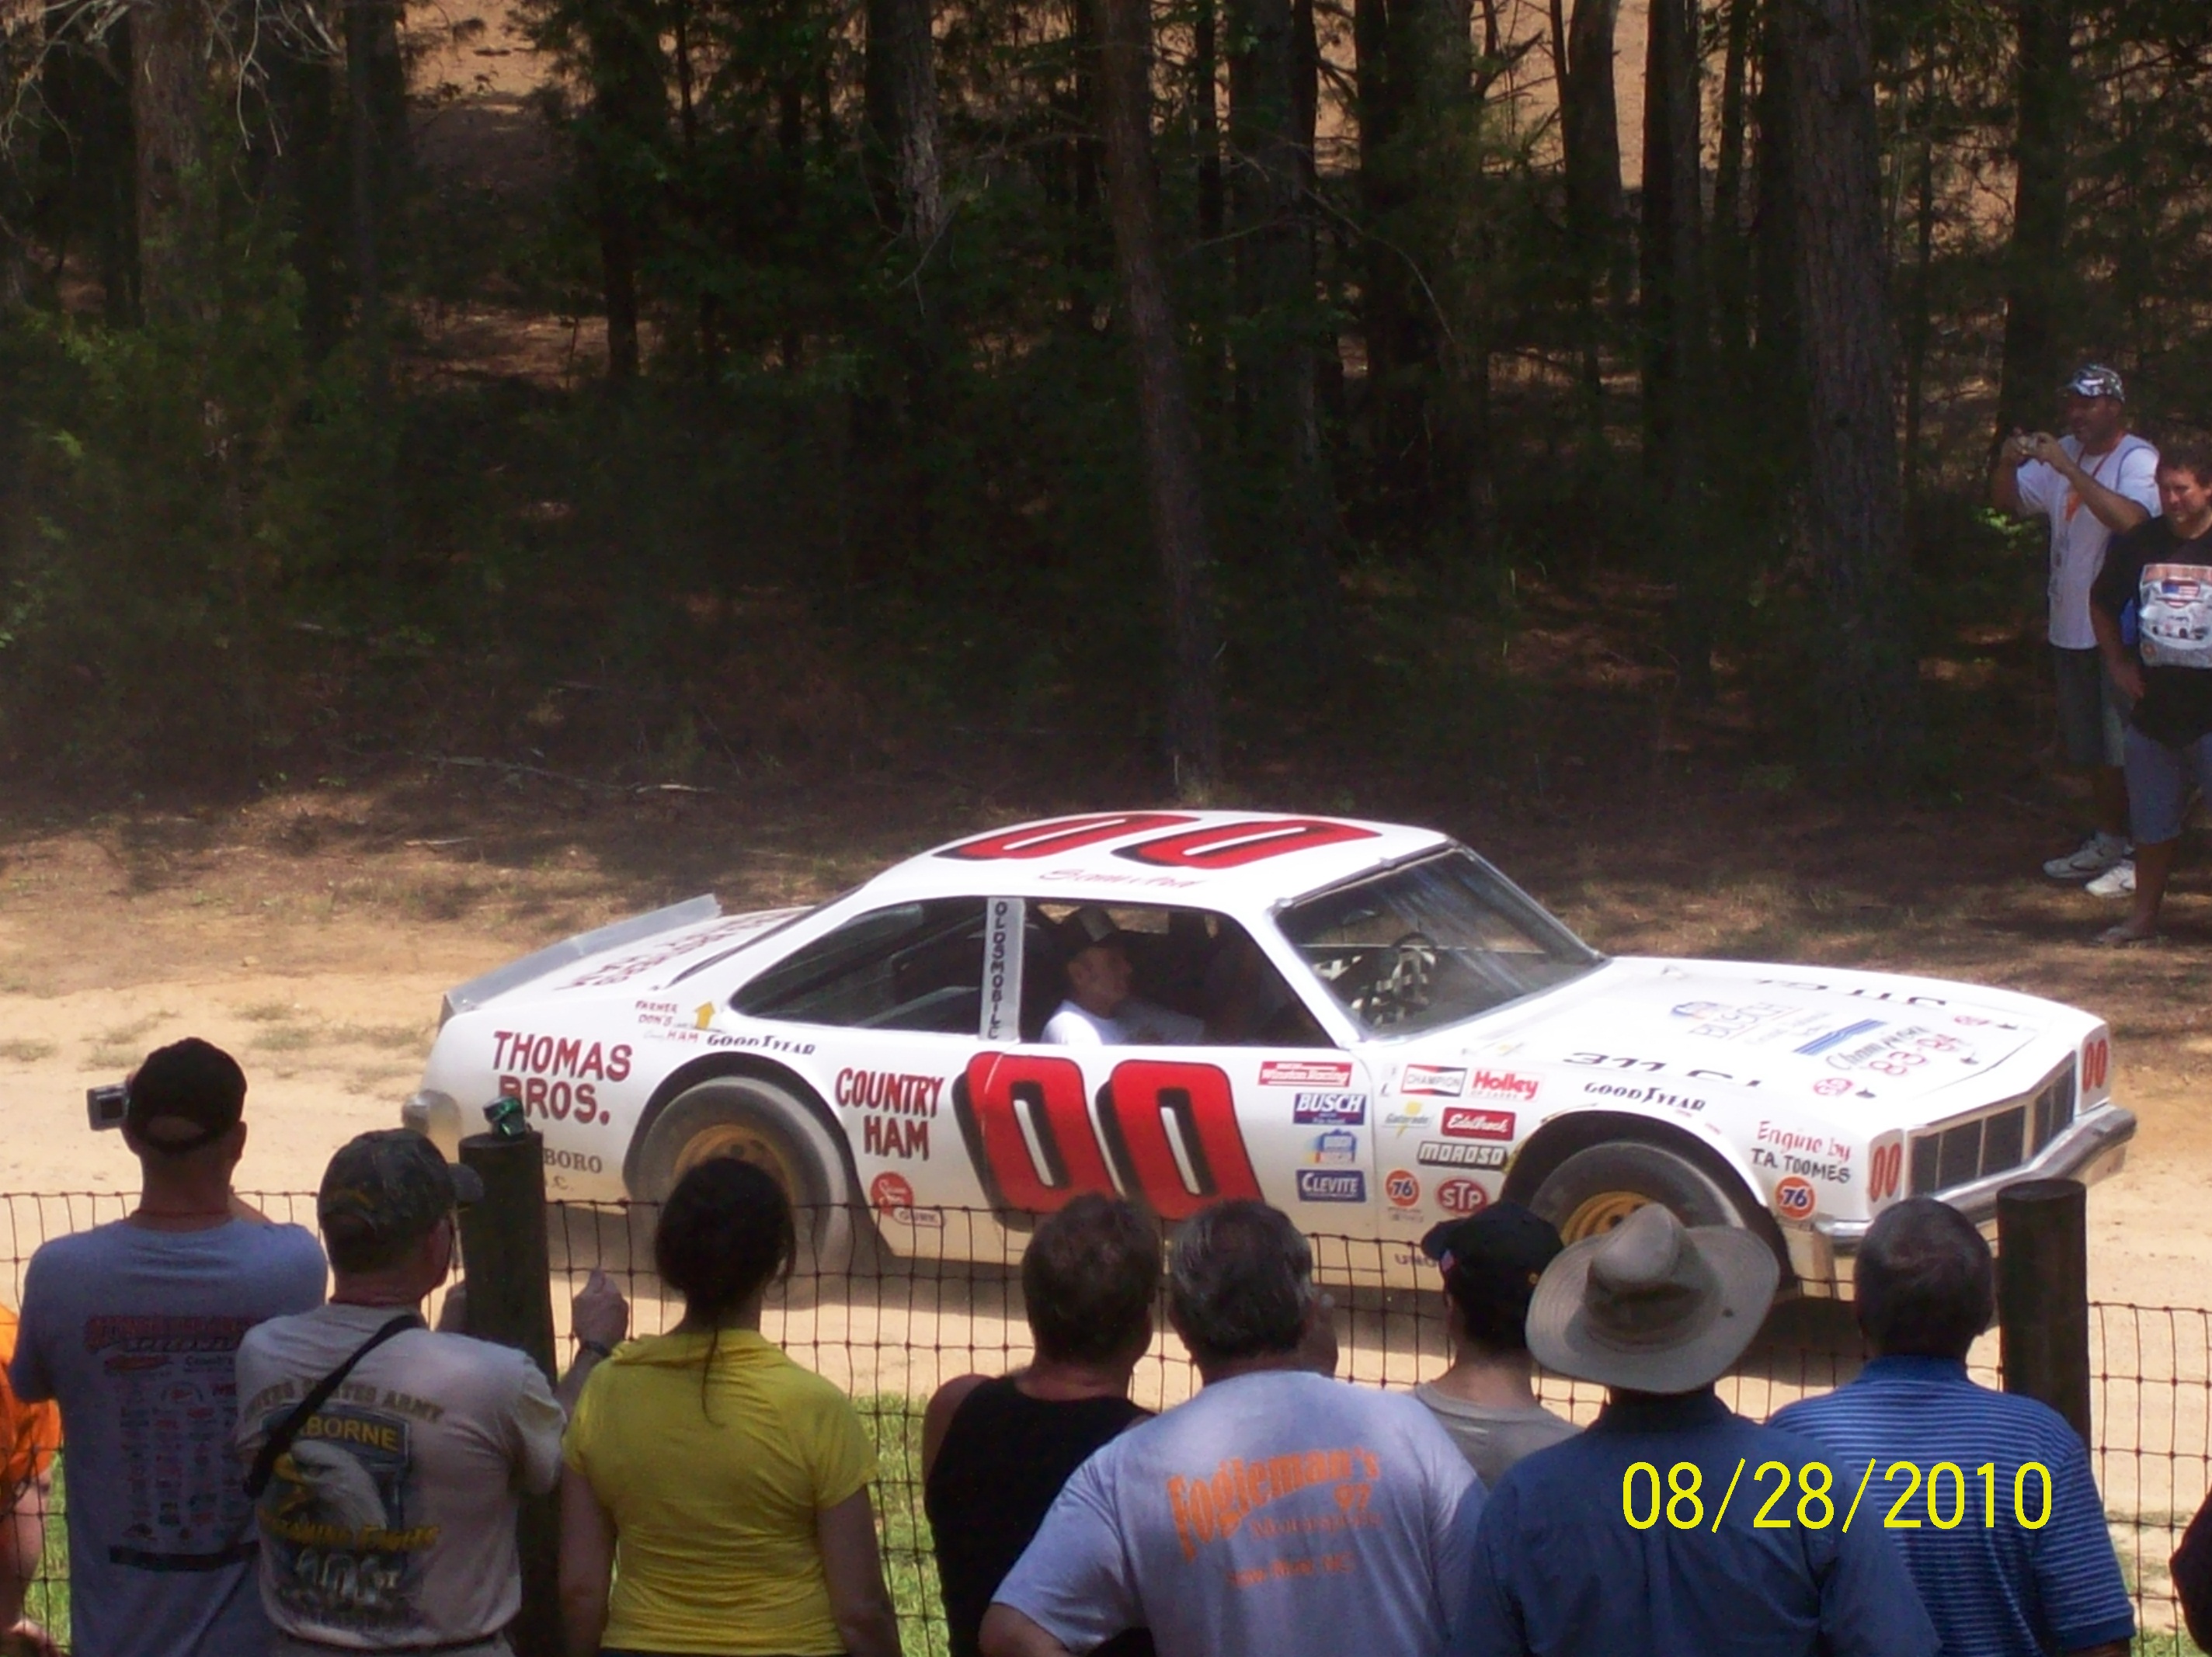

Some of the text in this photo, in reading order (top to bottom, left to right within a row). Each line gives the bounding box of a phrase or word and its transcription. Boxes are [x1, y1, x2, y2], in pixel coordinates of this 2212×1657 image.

[934, 813, 1382, 869] 00
[666, 1030, 699, 1043] HAM
[706, 1033, 816, 1056] GOODYEAR
[492, 1030, 633, 1082] THOMAS
[835, 1067, 944, 1118] COUNTRY
[1407, 1073, 1461, 1089] CHAMPION
[1471, 1069, 1540, 1101] Holley
[499, 1074, 610, 1126] BROS.
[1296, 1093, 1363, 1113] BUSCH
[1583, 1082, 1707, 1112] GOODYEAR
[863, 1114, 930, 1161] HAM
[951, 1051, 1268, 1233] 00
[1757, 1120, 1852, 1162] Engine by
[1418, 1142, 1505, 1165] MOROSO
[1302, 1172, 1358, 1193] CLEVITE
[1869, 1141, 1902, 1203] 00
[1392, 1180, 1414, 1197] 76
[1442, 1181, 1482, 1210] STP
[1782, 1188, 1808, 1207] 76
[297, 1415, 399, 1453] BORNE
